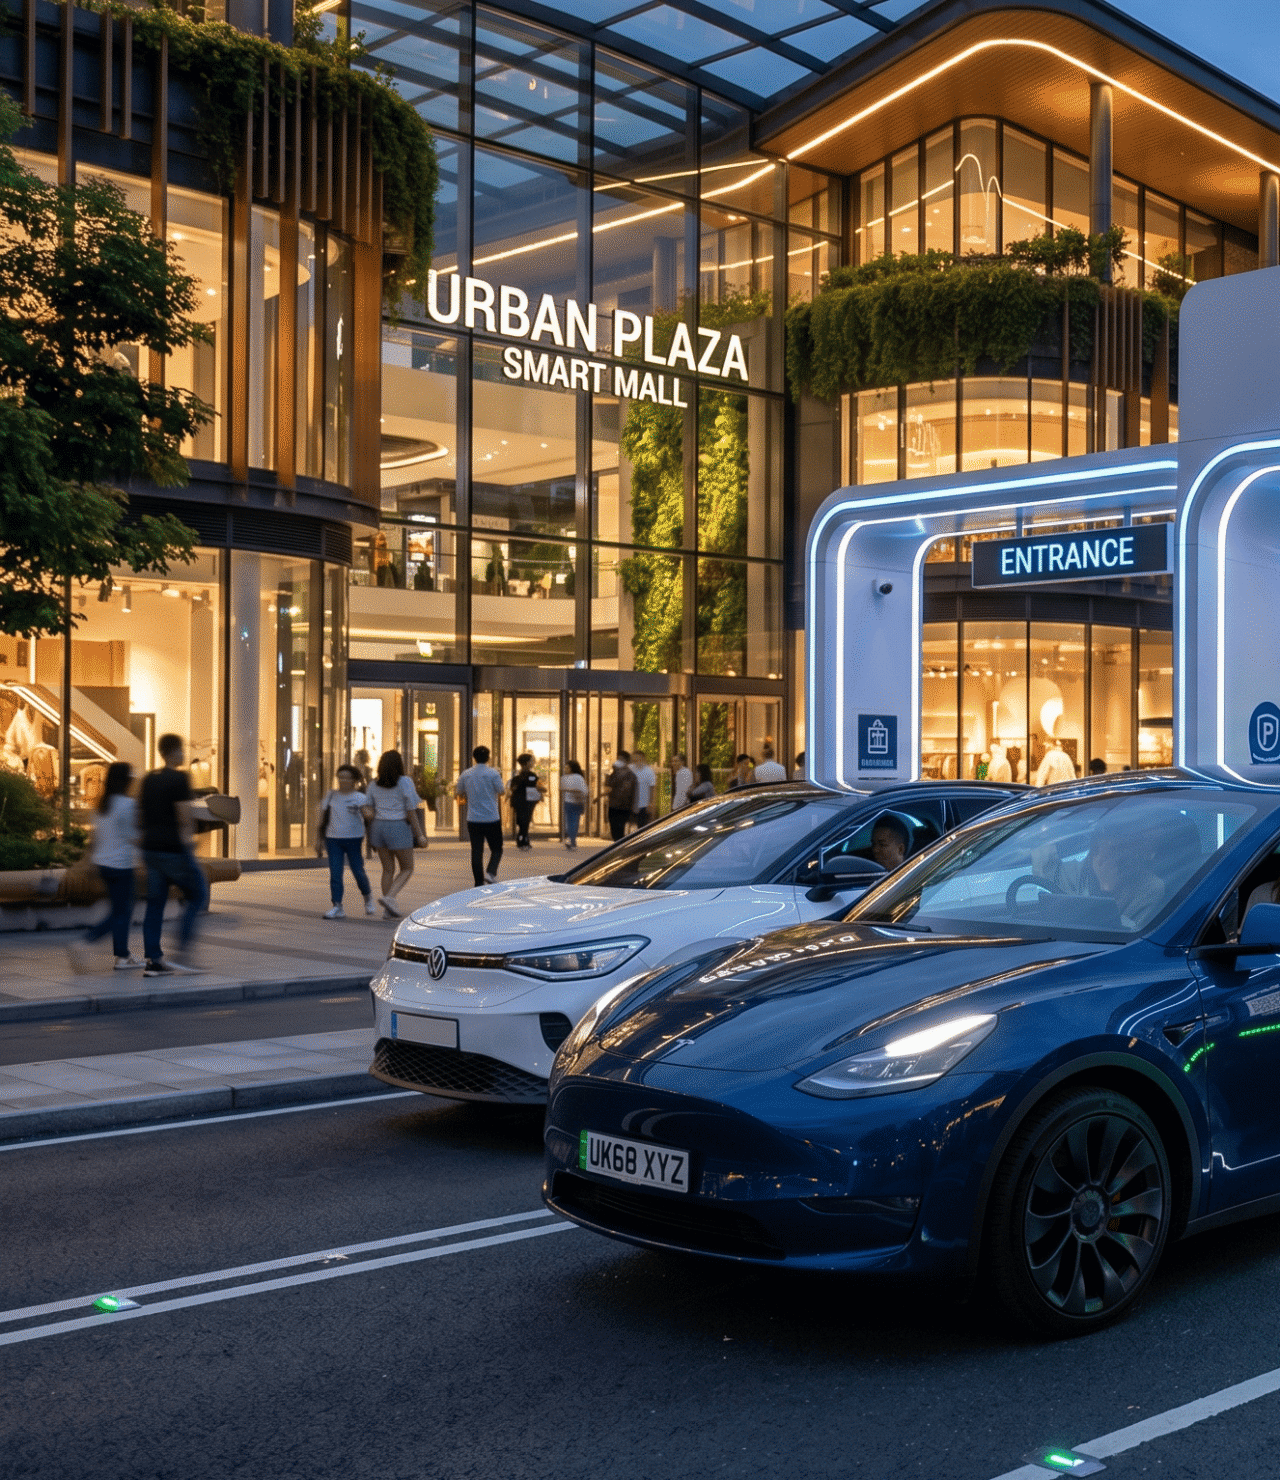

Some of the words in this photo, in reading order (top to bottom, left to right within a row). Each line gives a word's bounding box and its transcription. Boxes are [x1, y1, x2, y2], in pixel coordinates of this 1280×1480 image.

[427, 269, 597, 353] URBAN
[613, 309, 749, 381] PLAZA
[502, 347, 607, 393] SMART
[614, 369, 688, 408] MALL
[1001, 536, 1134, 575] ENTRANCE
[1263, 722, 1274, 746] P
[590, 1137, 637, 1175] UK68
[643, 1149, 684, 1185] XYZ
